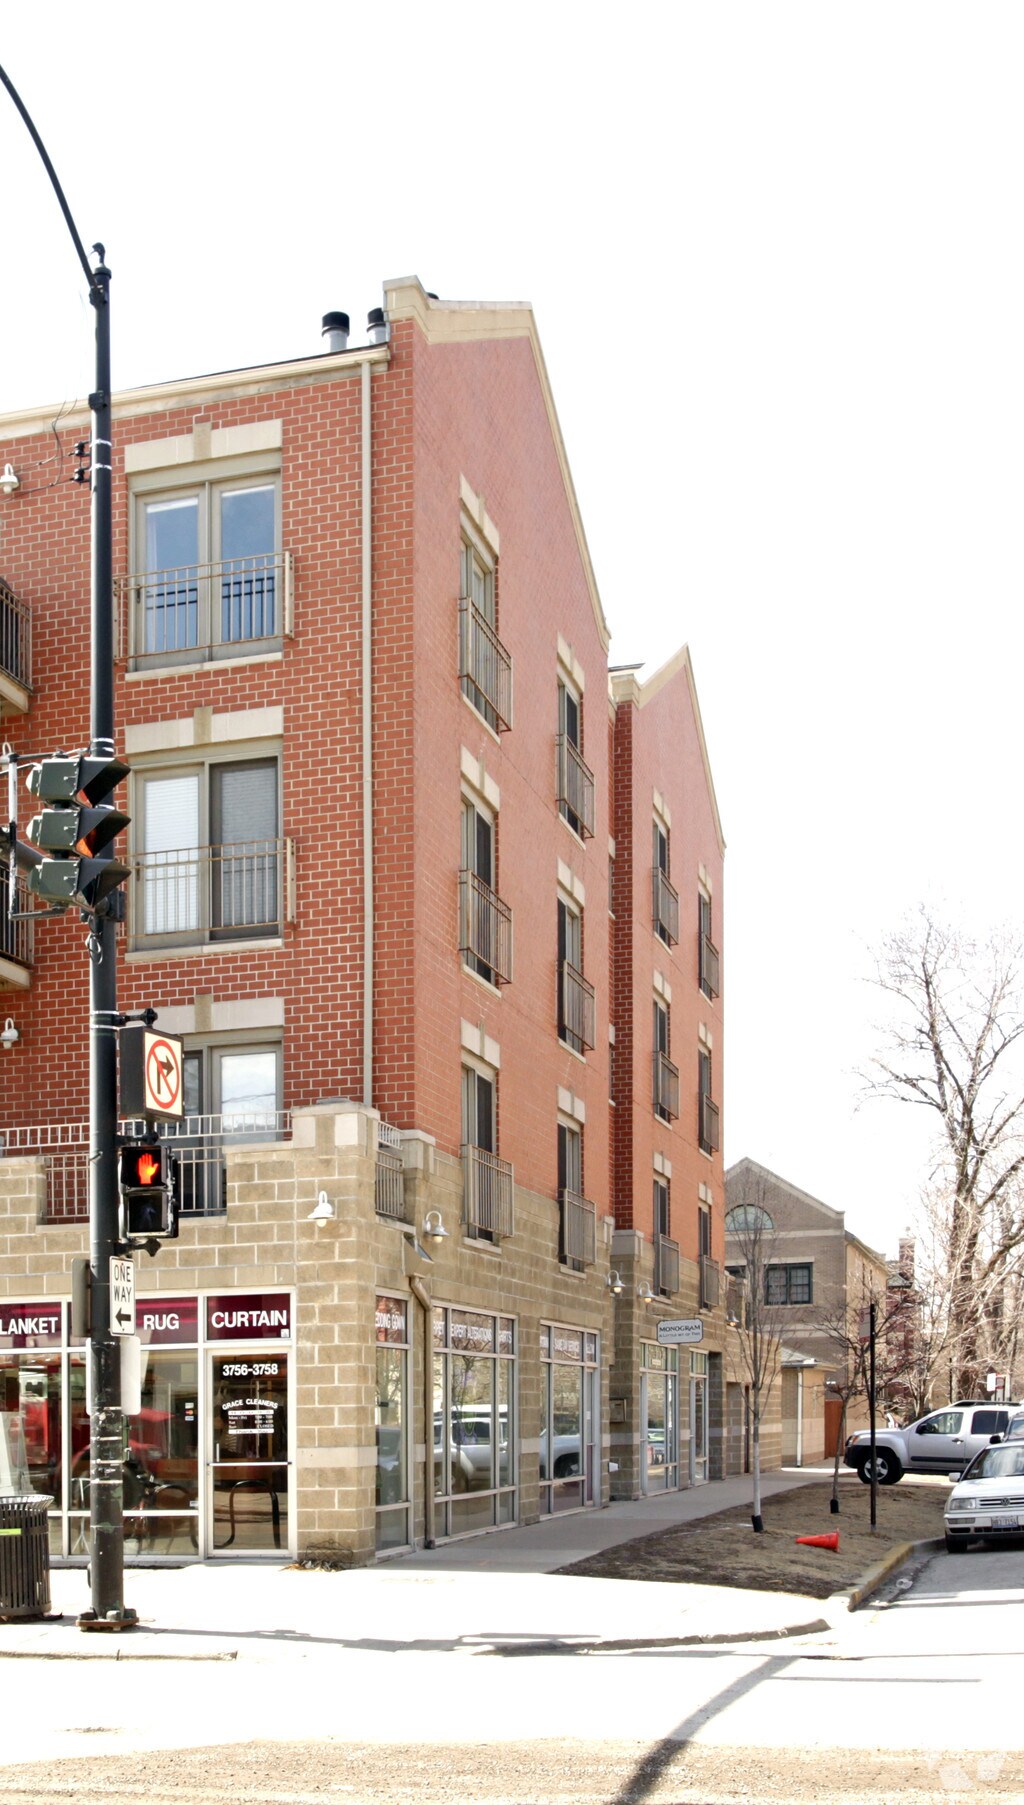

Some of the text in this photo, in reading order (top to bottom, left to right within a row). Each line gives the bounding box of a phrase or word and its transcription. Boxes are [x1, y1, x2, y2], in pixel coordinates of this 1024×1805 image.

[114, 1264, 131, 1282] ONE
[113, 1285, 132, 1302] WAY
[143, 1313, 179, 1330] RUG
[211, 1310, 287, 1328] CURTAIN
[659, 1325, 701, 1333] MONOGRAM
[222, 1363, 279, 1376] 3756-3758
[221, 1398, 279, 1410] GRACE CLEANERS
